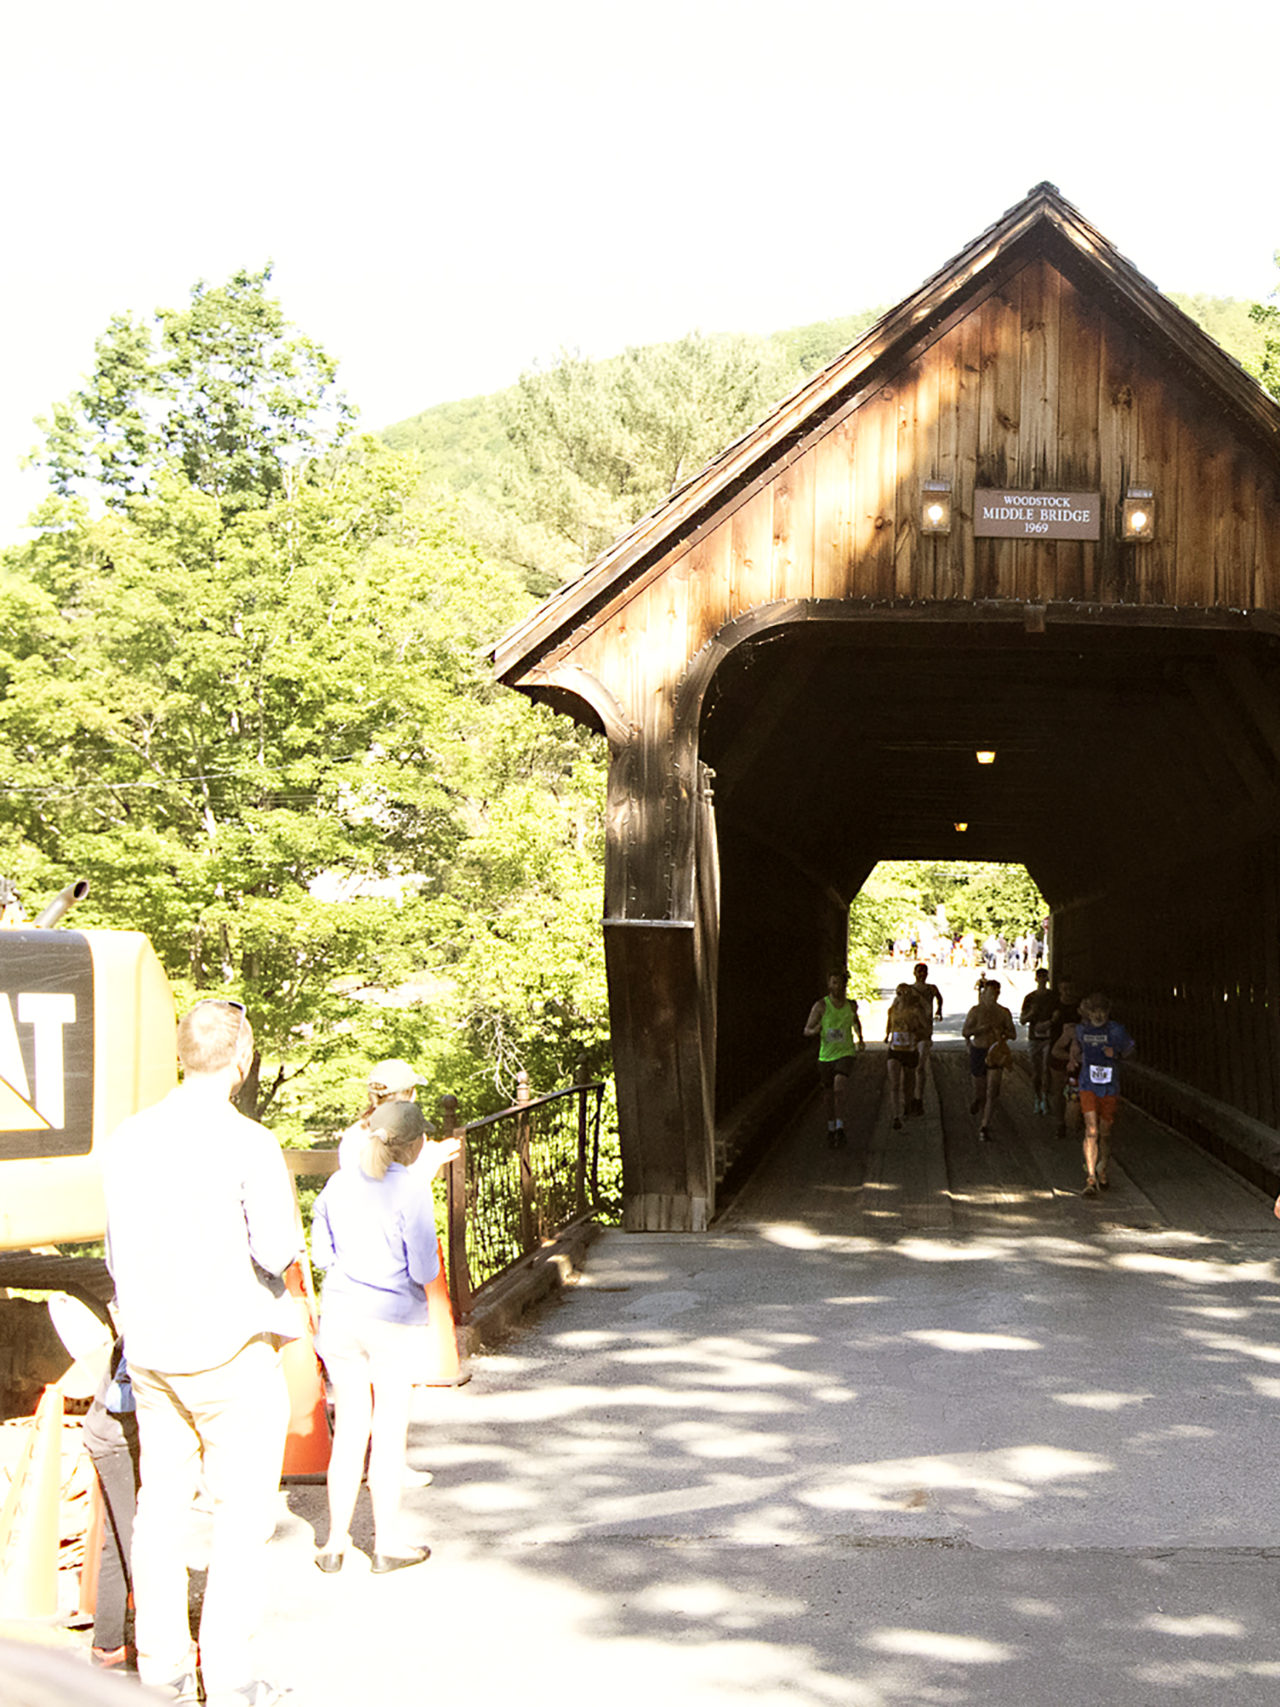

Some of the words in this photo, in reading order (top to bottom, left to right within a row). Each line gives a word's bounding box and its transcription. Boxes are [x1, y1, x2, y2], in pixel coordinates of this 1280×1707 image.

[1003, 495, 1071, 508] WOODSTOCK
[983, 506, 1034, 520] MIDDLE
[1040, 508, 1091, 522] BRIDGE
[1024, 522, 1049, 533] 1969
